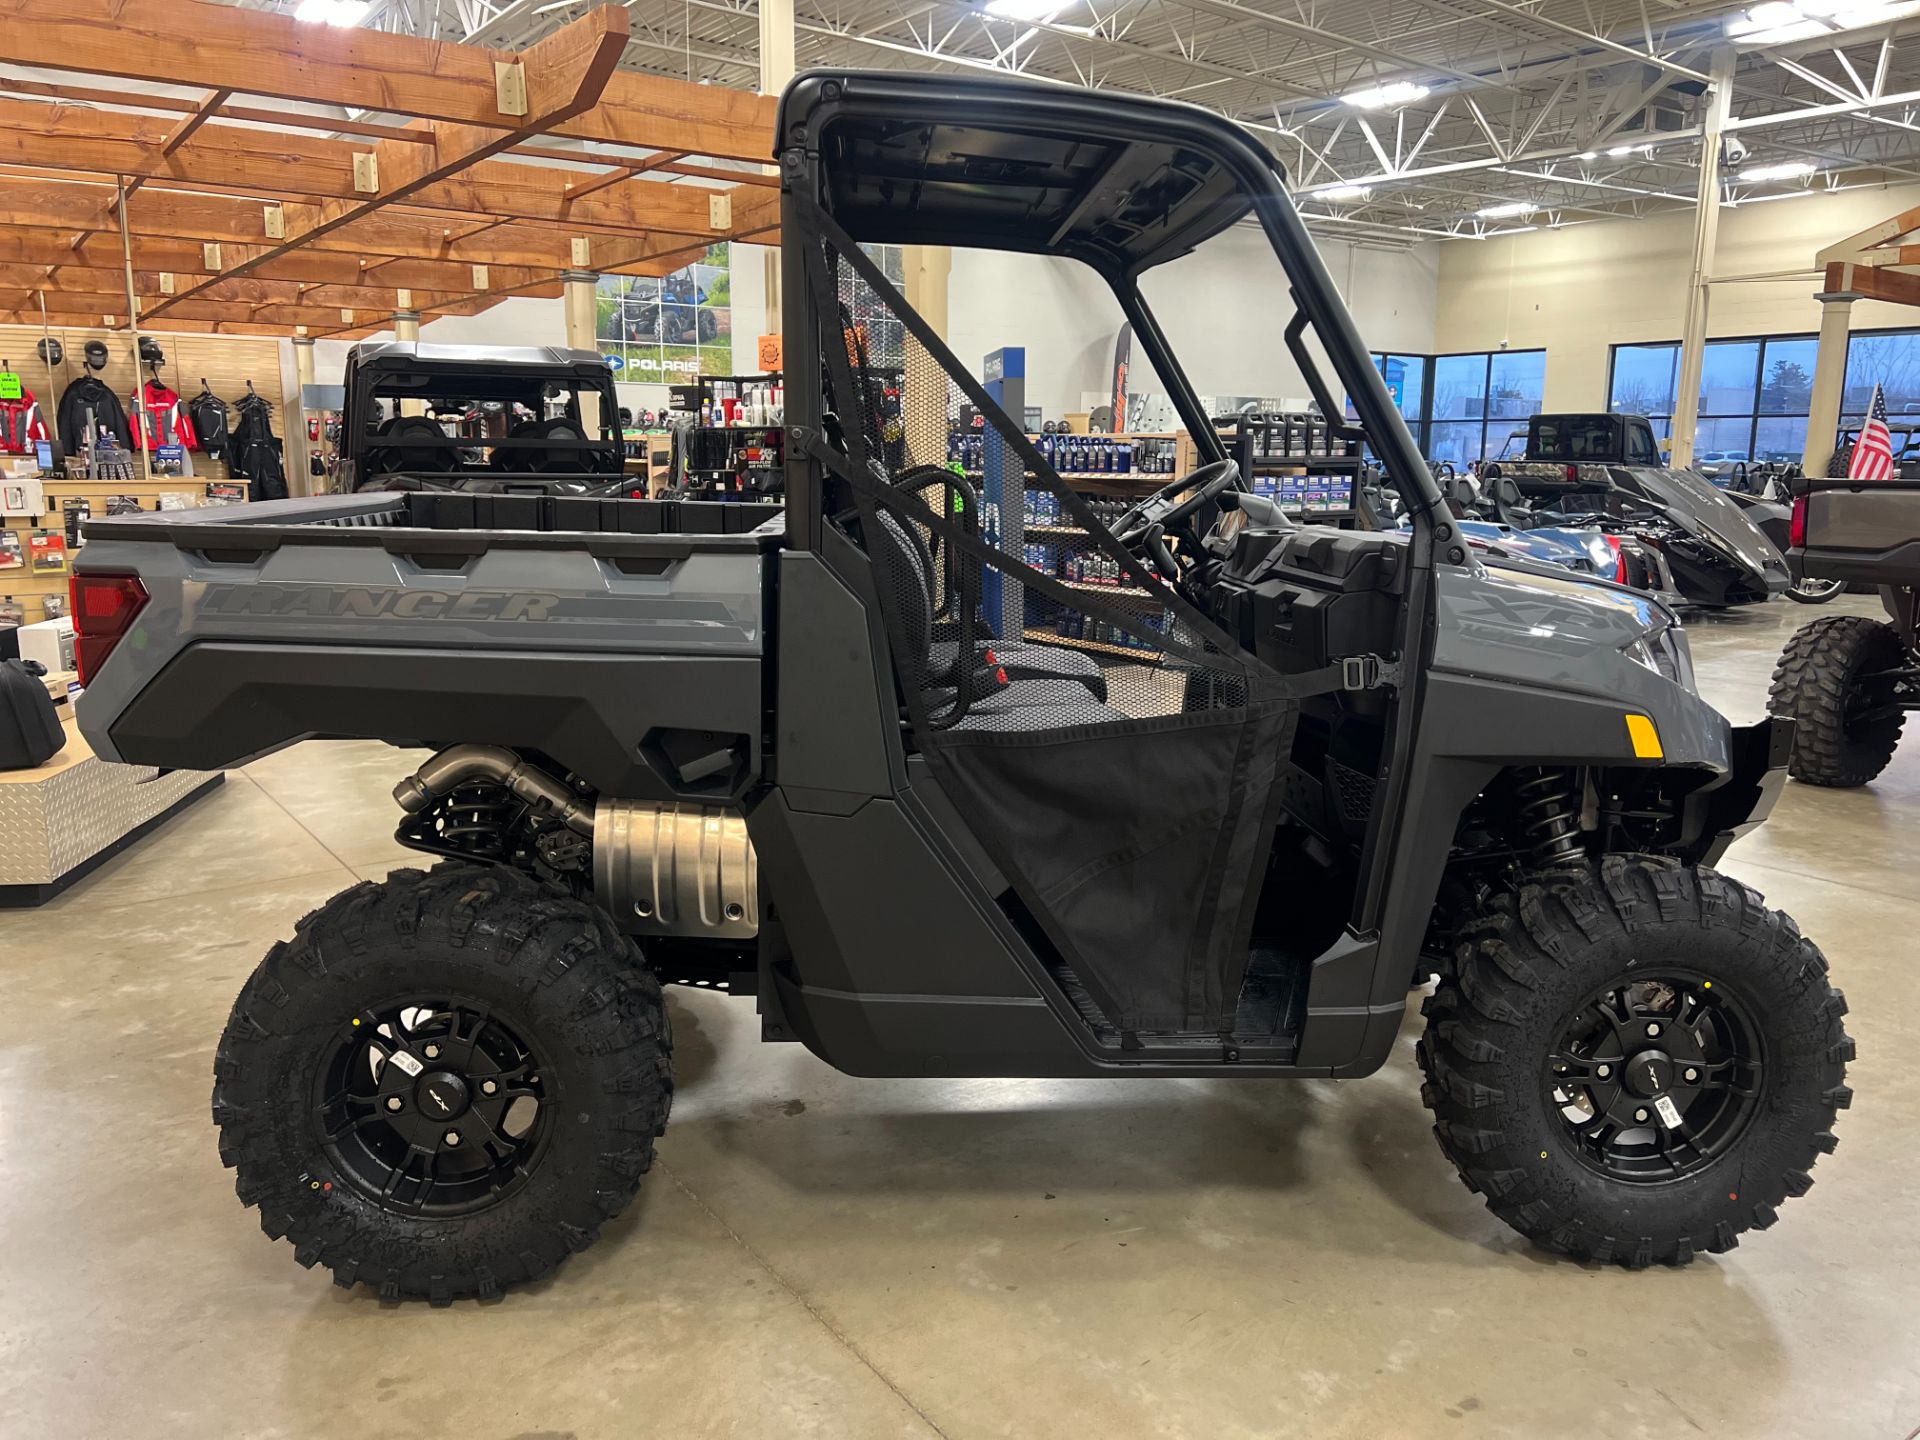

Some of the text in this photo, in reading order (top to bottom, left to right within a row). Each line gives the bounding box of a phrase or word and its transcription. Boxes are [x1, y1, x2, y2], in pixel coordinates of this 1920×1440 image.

[629, 358, 699, 372] POLARIS
[215, 584, 562, 621] RANGER
[1459, 592, 1611, 632] XP
